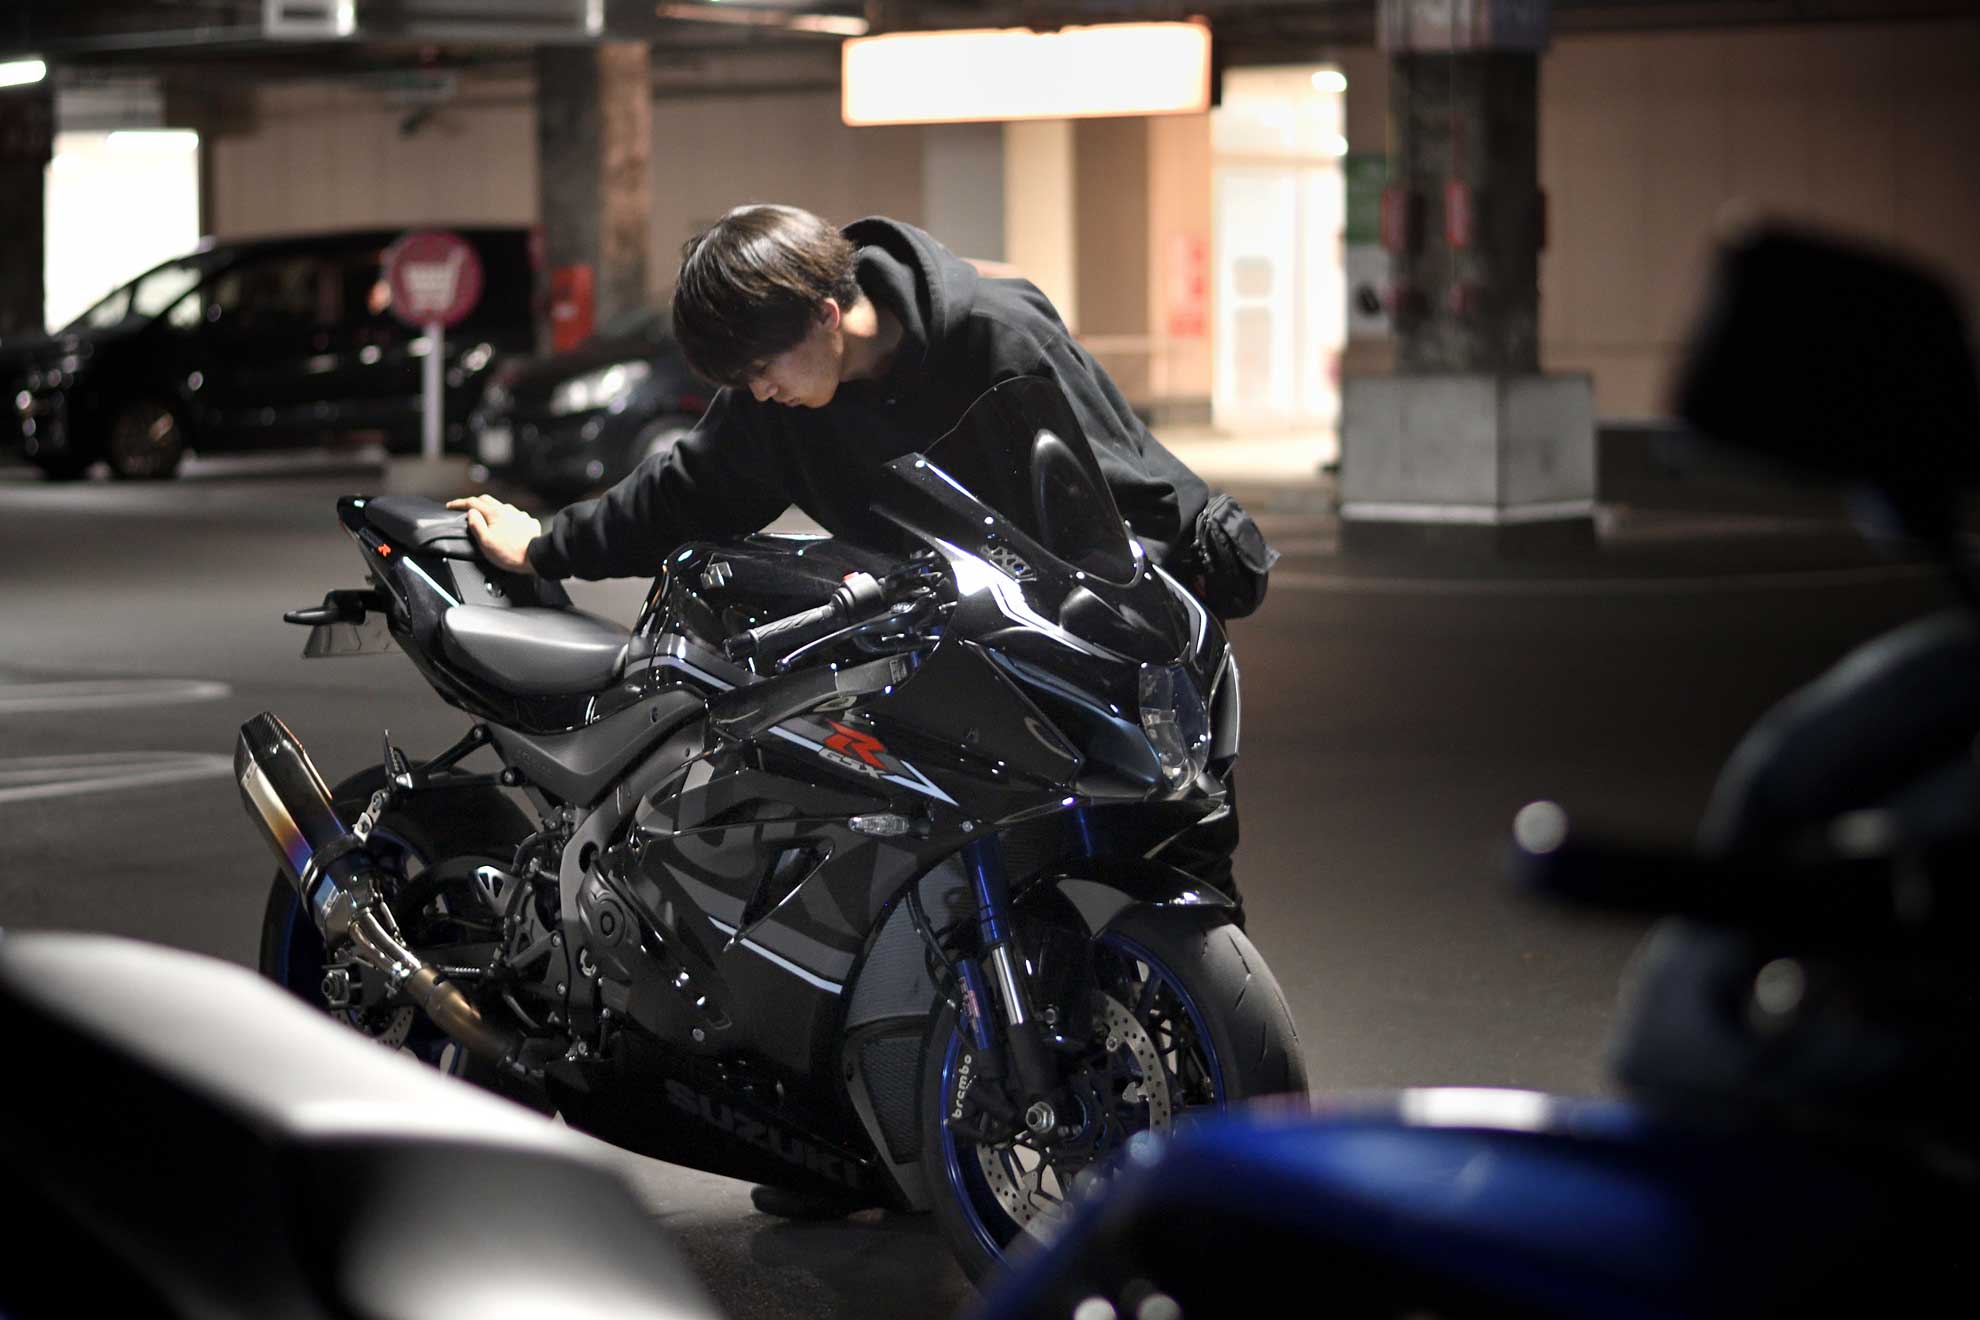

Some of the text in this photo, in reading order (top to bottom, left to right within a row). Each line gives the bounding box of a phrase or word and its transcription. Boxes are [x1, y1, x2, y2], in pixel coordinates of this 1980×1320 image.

[818, 748, 888, 779] GSX
[951, 1054, 972, 1119] brembo
[664, 1078, 859, 1190] SUZUKI
